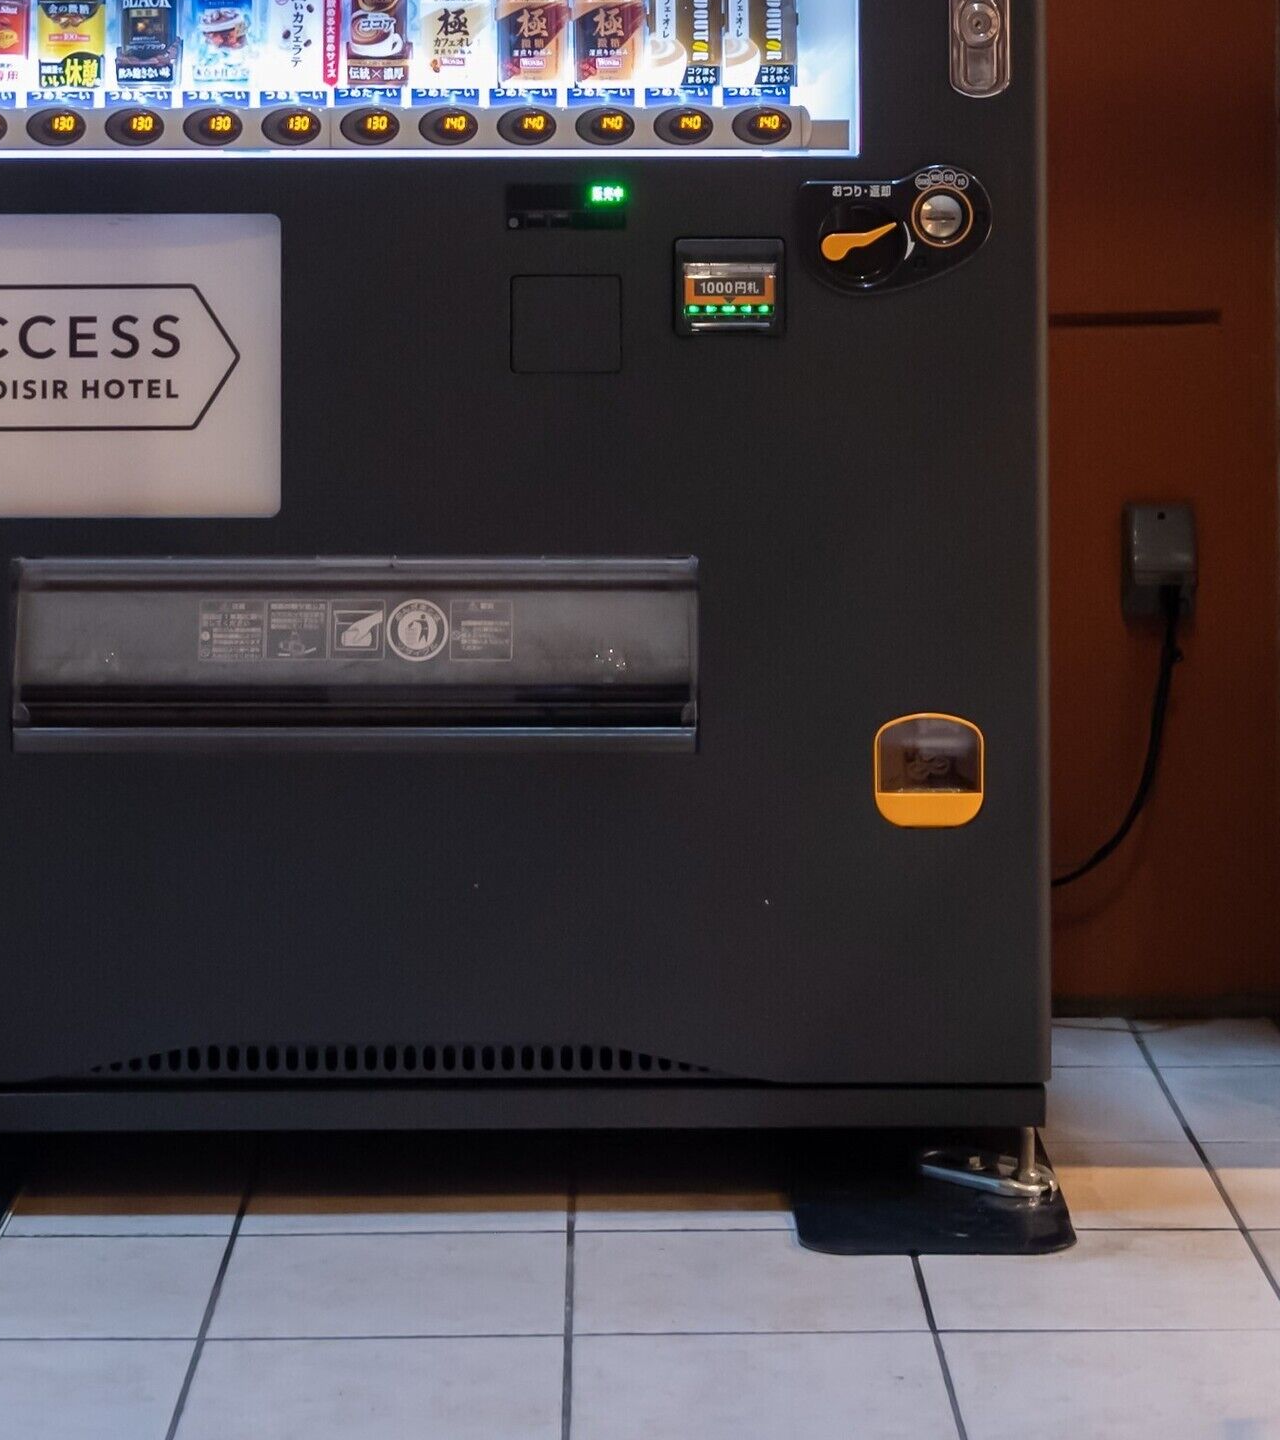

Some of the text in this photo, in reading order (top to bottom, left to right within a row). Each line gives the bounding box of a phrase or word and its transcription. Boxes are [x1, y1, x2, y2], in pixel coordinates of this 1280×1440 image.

[360, 19, 394, 31] ココア
[436, 8, 470, 36] 極
[516, 8, 549, 37] 極
[592, 8, 625, 37] 極
[433, 37, 472, 48] カフェオレ
[687, 75, 717, 83] まろやか
[761, 75, 790, 84] まろやか
[54, 116, 75, 131] 130
[132, 116, 153, 131] 130
[210, 116, 232, 131] 130
[289, 115, 310, 131] 130
[367, 115, 388, 131] 130
[445, 116, 466, 131] 140
[523, 115, 545, 130] 140
[602, 115, 623, 130] 140
[681, 115, 702, 130] 140
[759, 115, 780, 130] 140
[832, 185, 892, 197] おつり・返却
[700, 281, 759, 294] 1000円札
[81, 378, 180, 400] HOTEL
